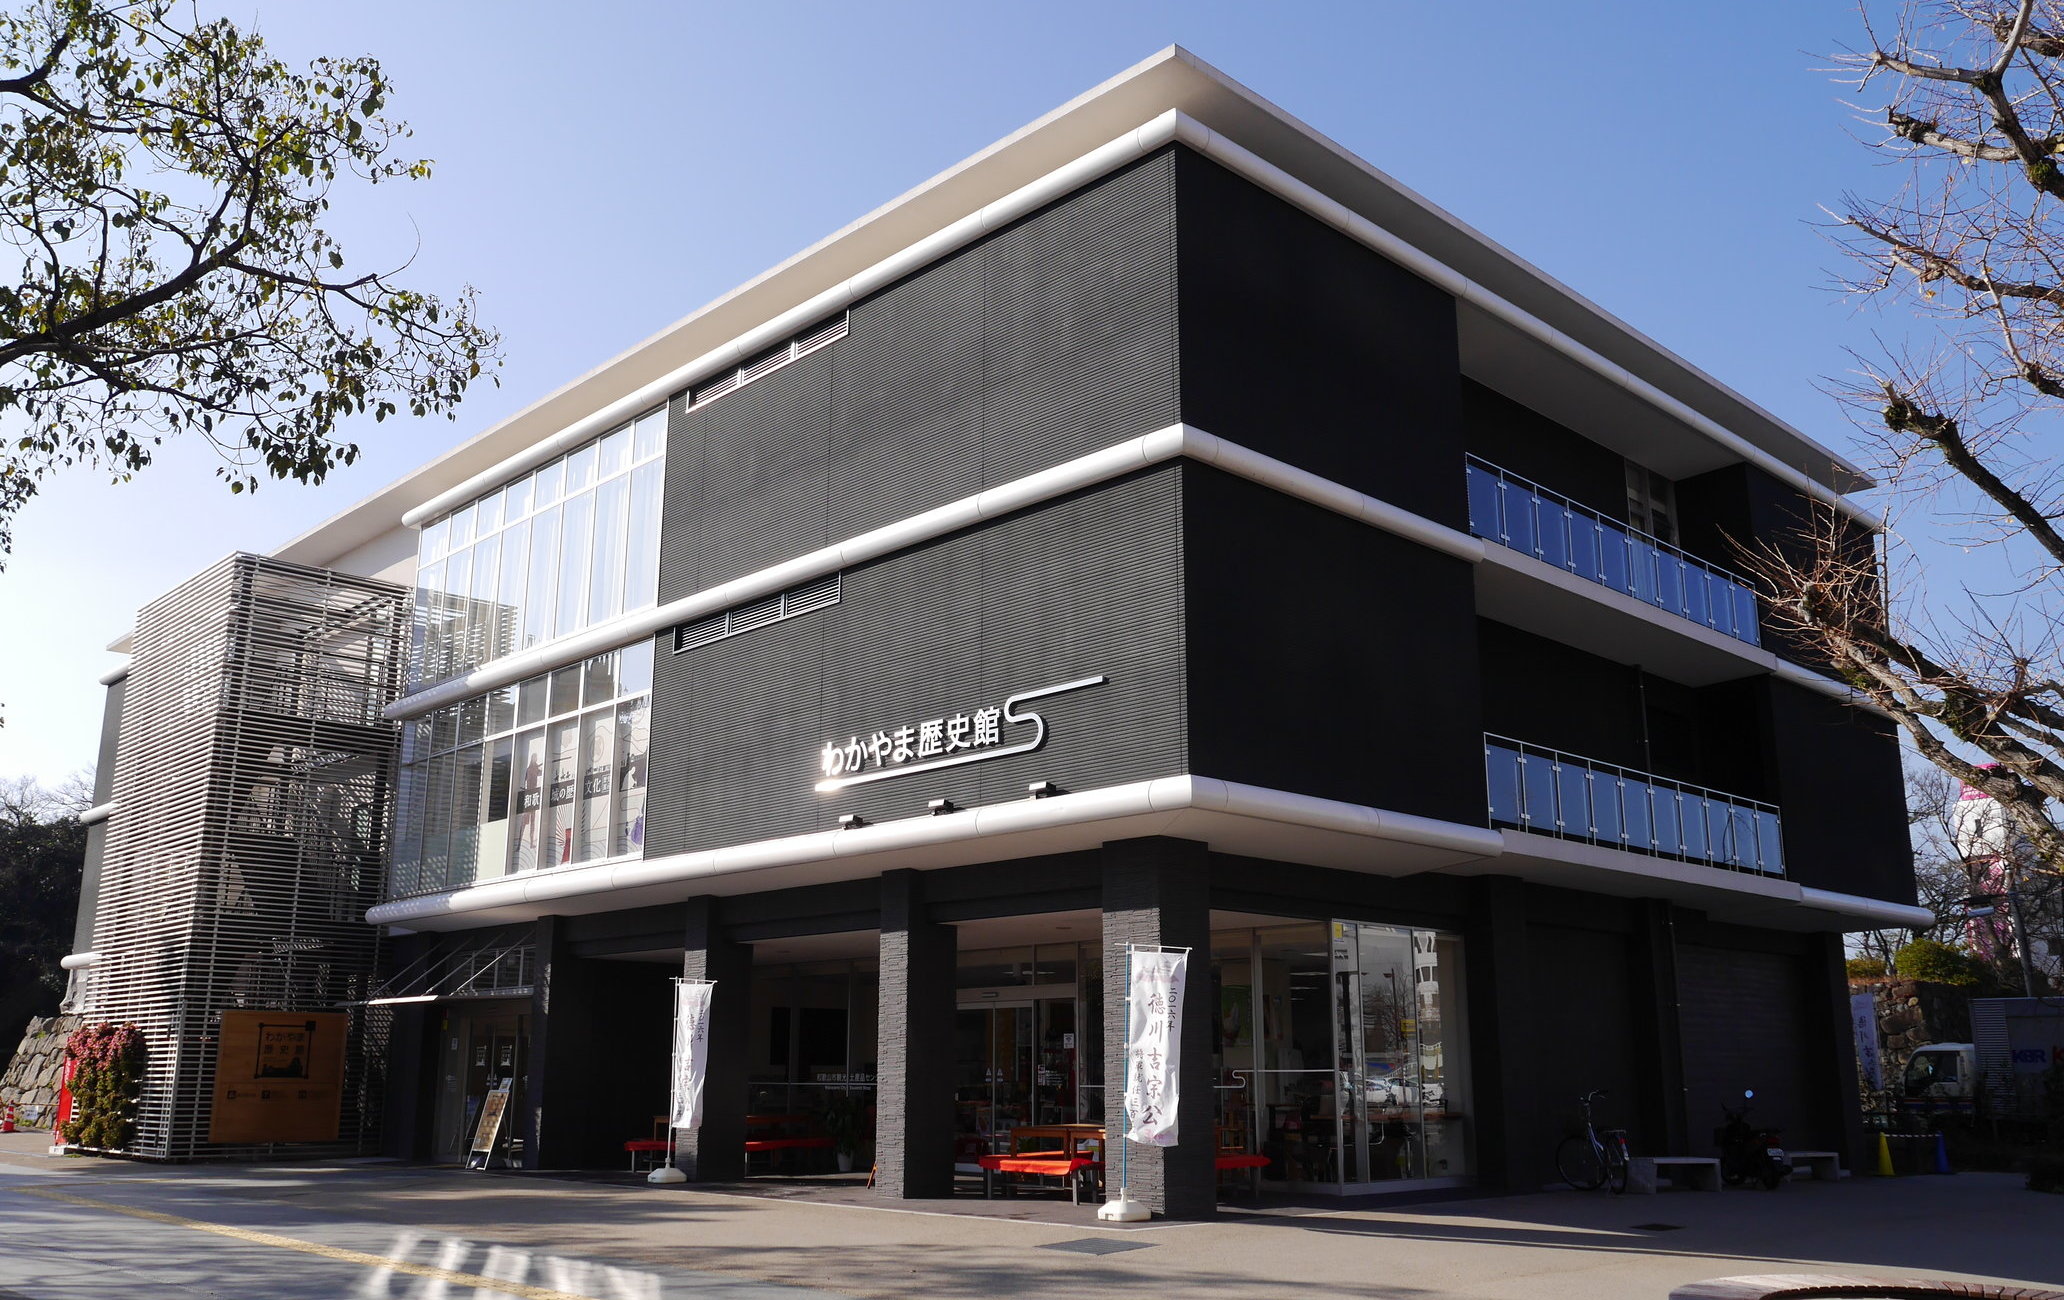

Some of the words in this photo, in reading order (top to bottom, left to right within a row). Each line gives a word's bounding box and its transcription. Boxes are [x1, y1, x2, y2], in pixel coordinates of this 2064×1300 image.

[821, 706, 1001, 777] わかやま歴史館
[1142, 992, 1167, 1126] 徳川吉宗公
